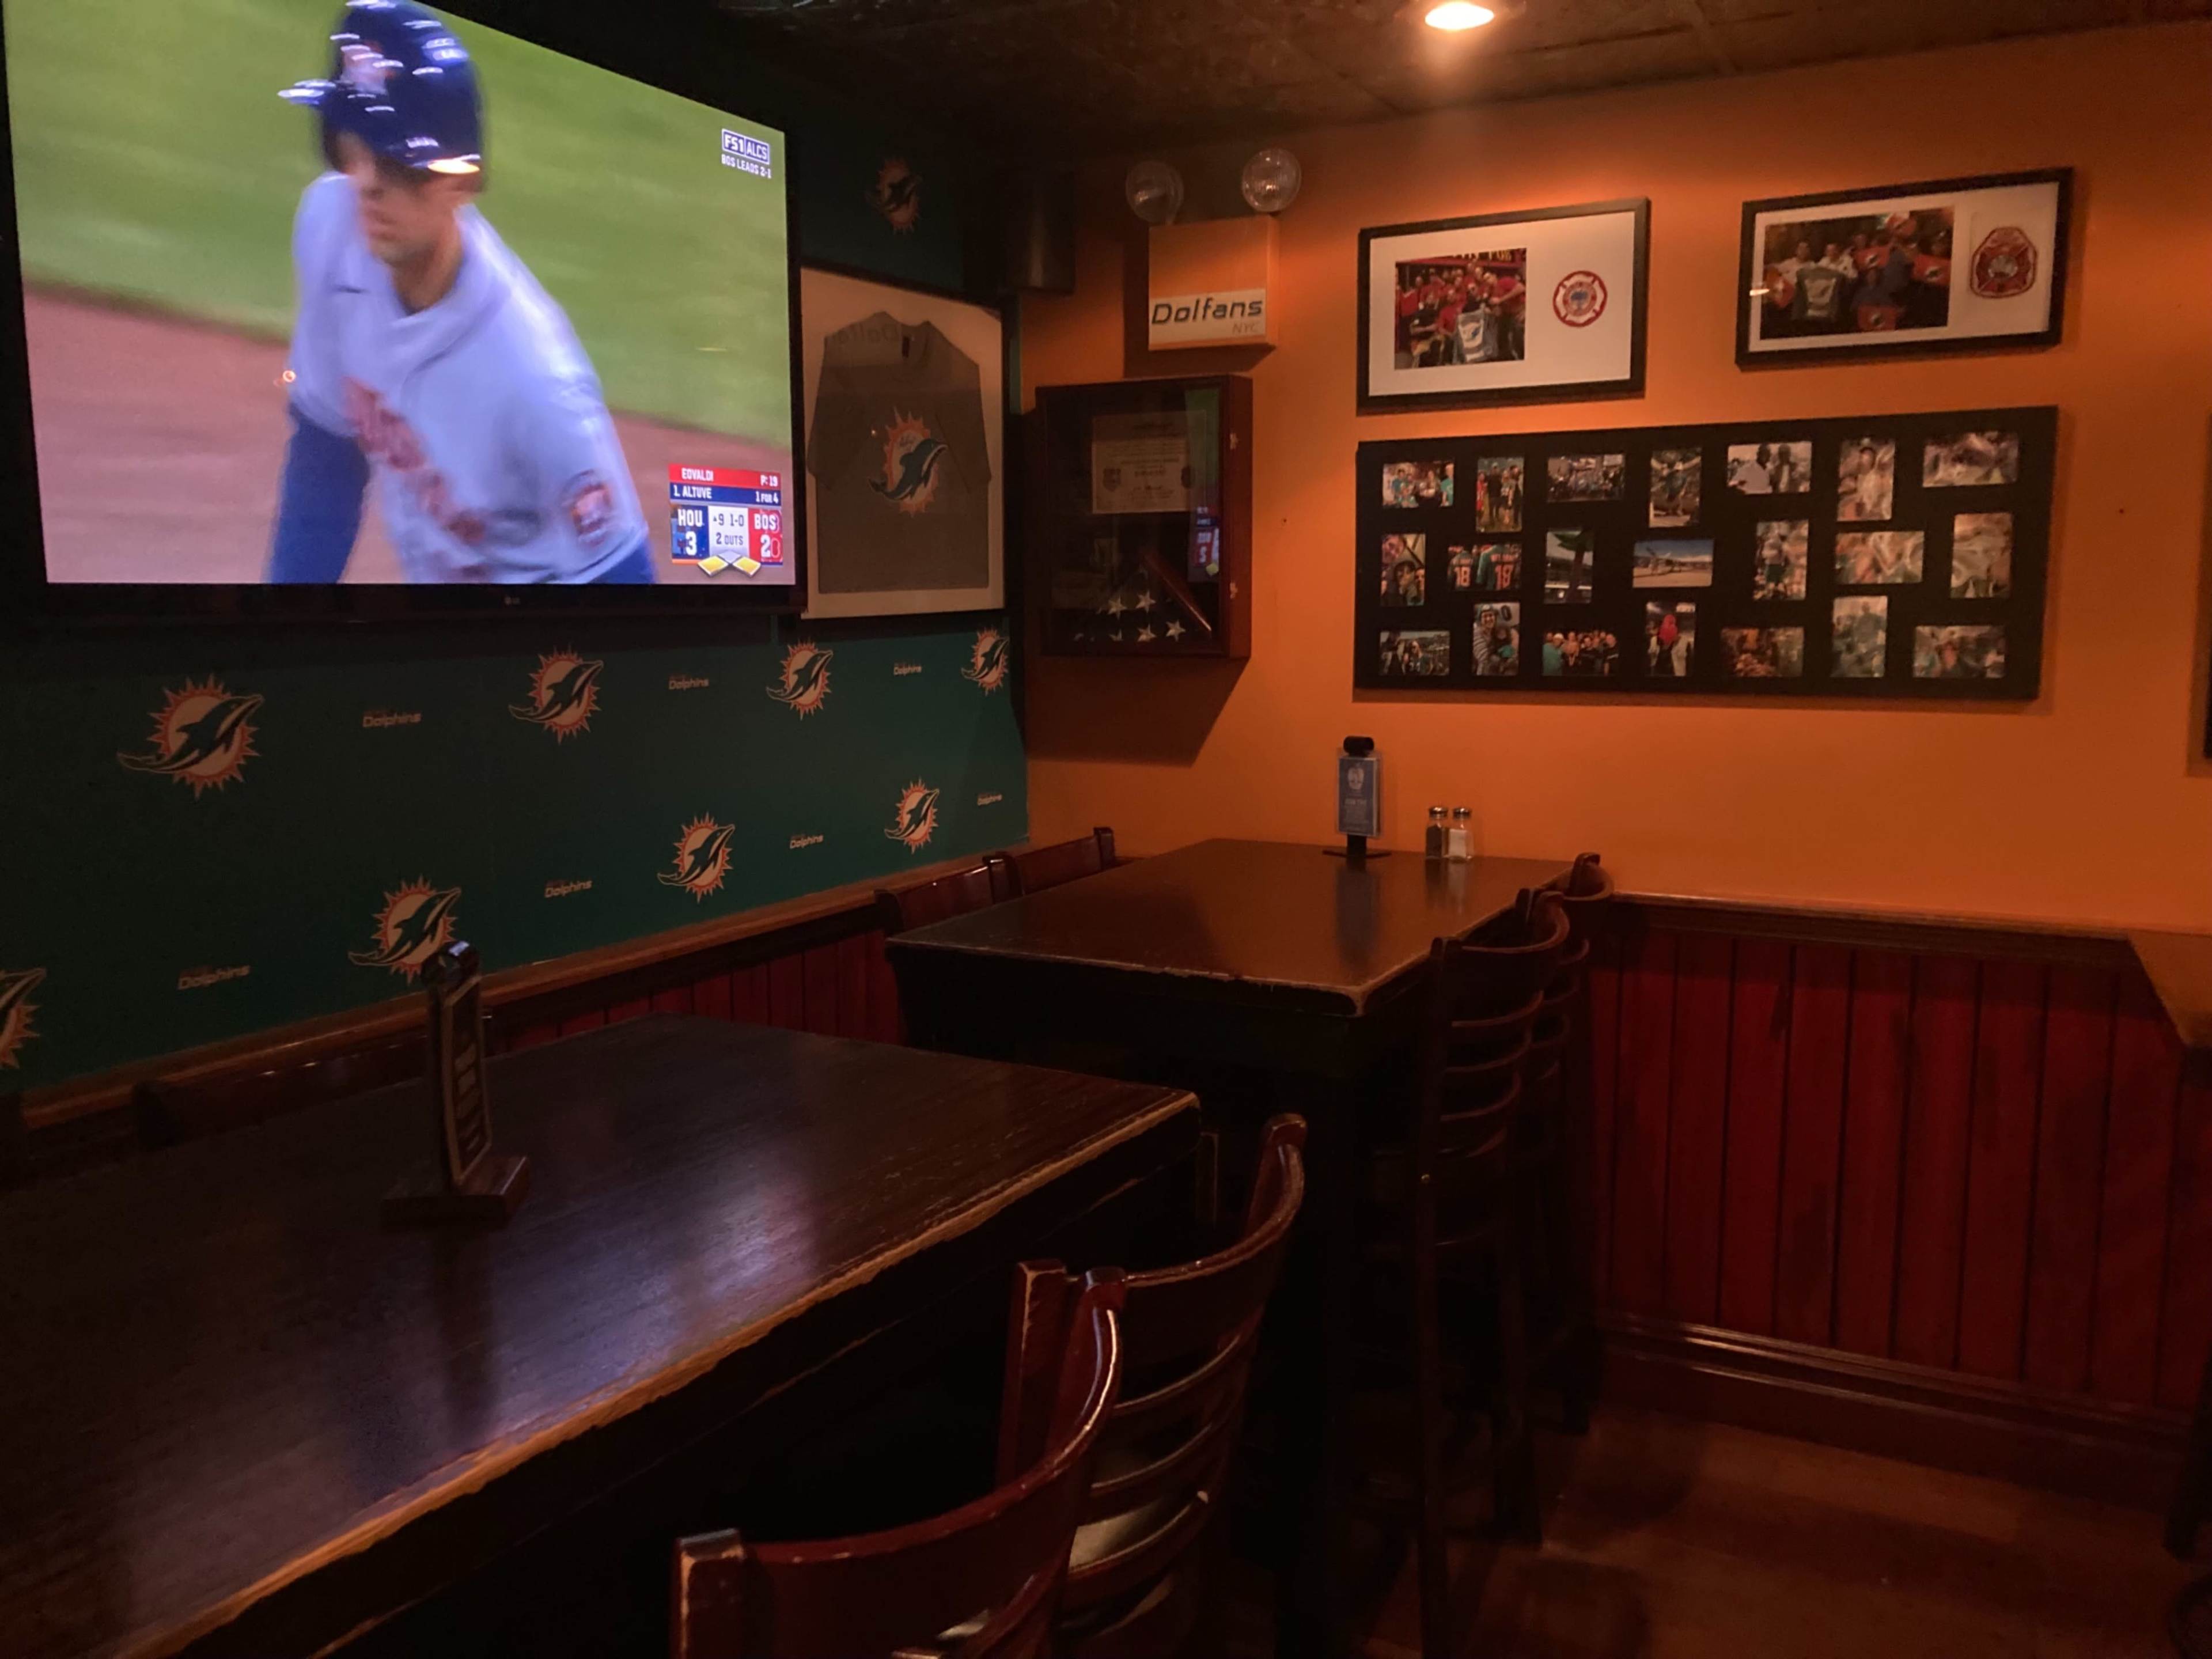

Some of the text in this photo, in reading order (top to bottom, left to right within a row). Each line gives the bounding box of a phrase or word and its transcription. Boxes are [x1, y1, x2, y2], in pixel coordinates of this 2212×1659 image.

[725, 134, 767, 160] FS1 ALCS
[721, 154, 771, 179] BOS LEADS 2-1
[1152, 297, 1262, 324] Dolfans
[1232, 322, 1258, 334] NYC
[681, 468, 714, 482] EOVALDI
[683, 485, 712, 499] ALTUVE
[761, 493, 772, 503] FOR
[773, 493, 778, 503] 4
[677, 509, 703, 527] HOU
[718, 514, 744, 527] 9 1-0
[754, 513, 777, 530] BOS
[685, 531, 697, 556] 3
[716, 533, 744, 545] 2 OUTS
[760, 534, 771, 558] 2
[1454, 566, 1471, 587] 18
[1495, 564, 1514, 590] 18
[893, 665, 922, 676] Dolphins
[668, 678, 709, 691] Dolphins
[362, 712, 422, 729] Dolphins
[789, 834, 824, 849] Dolphins
[544, 880, 592, 898] Dolphins
[177, 964, 251, 990] Dolphins
